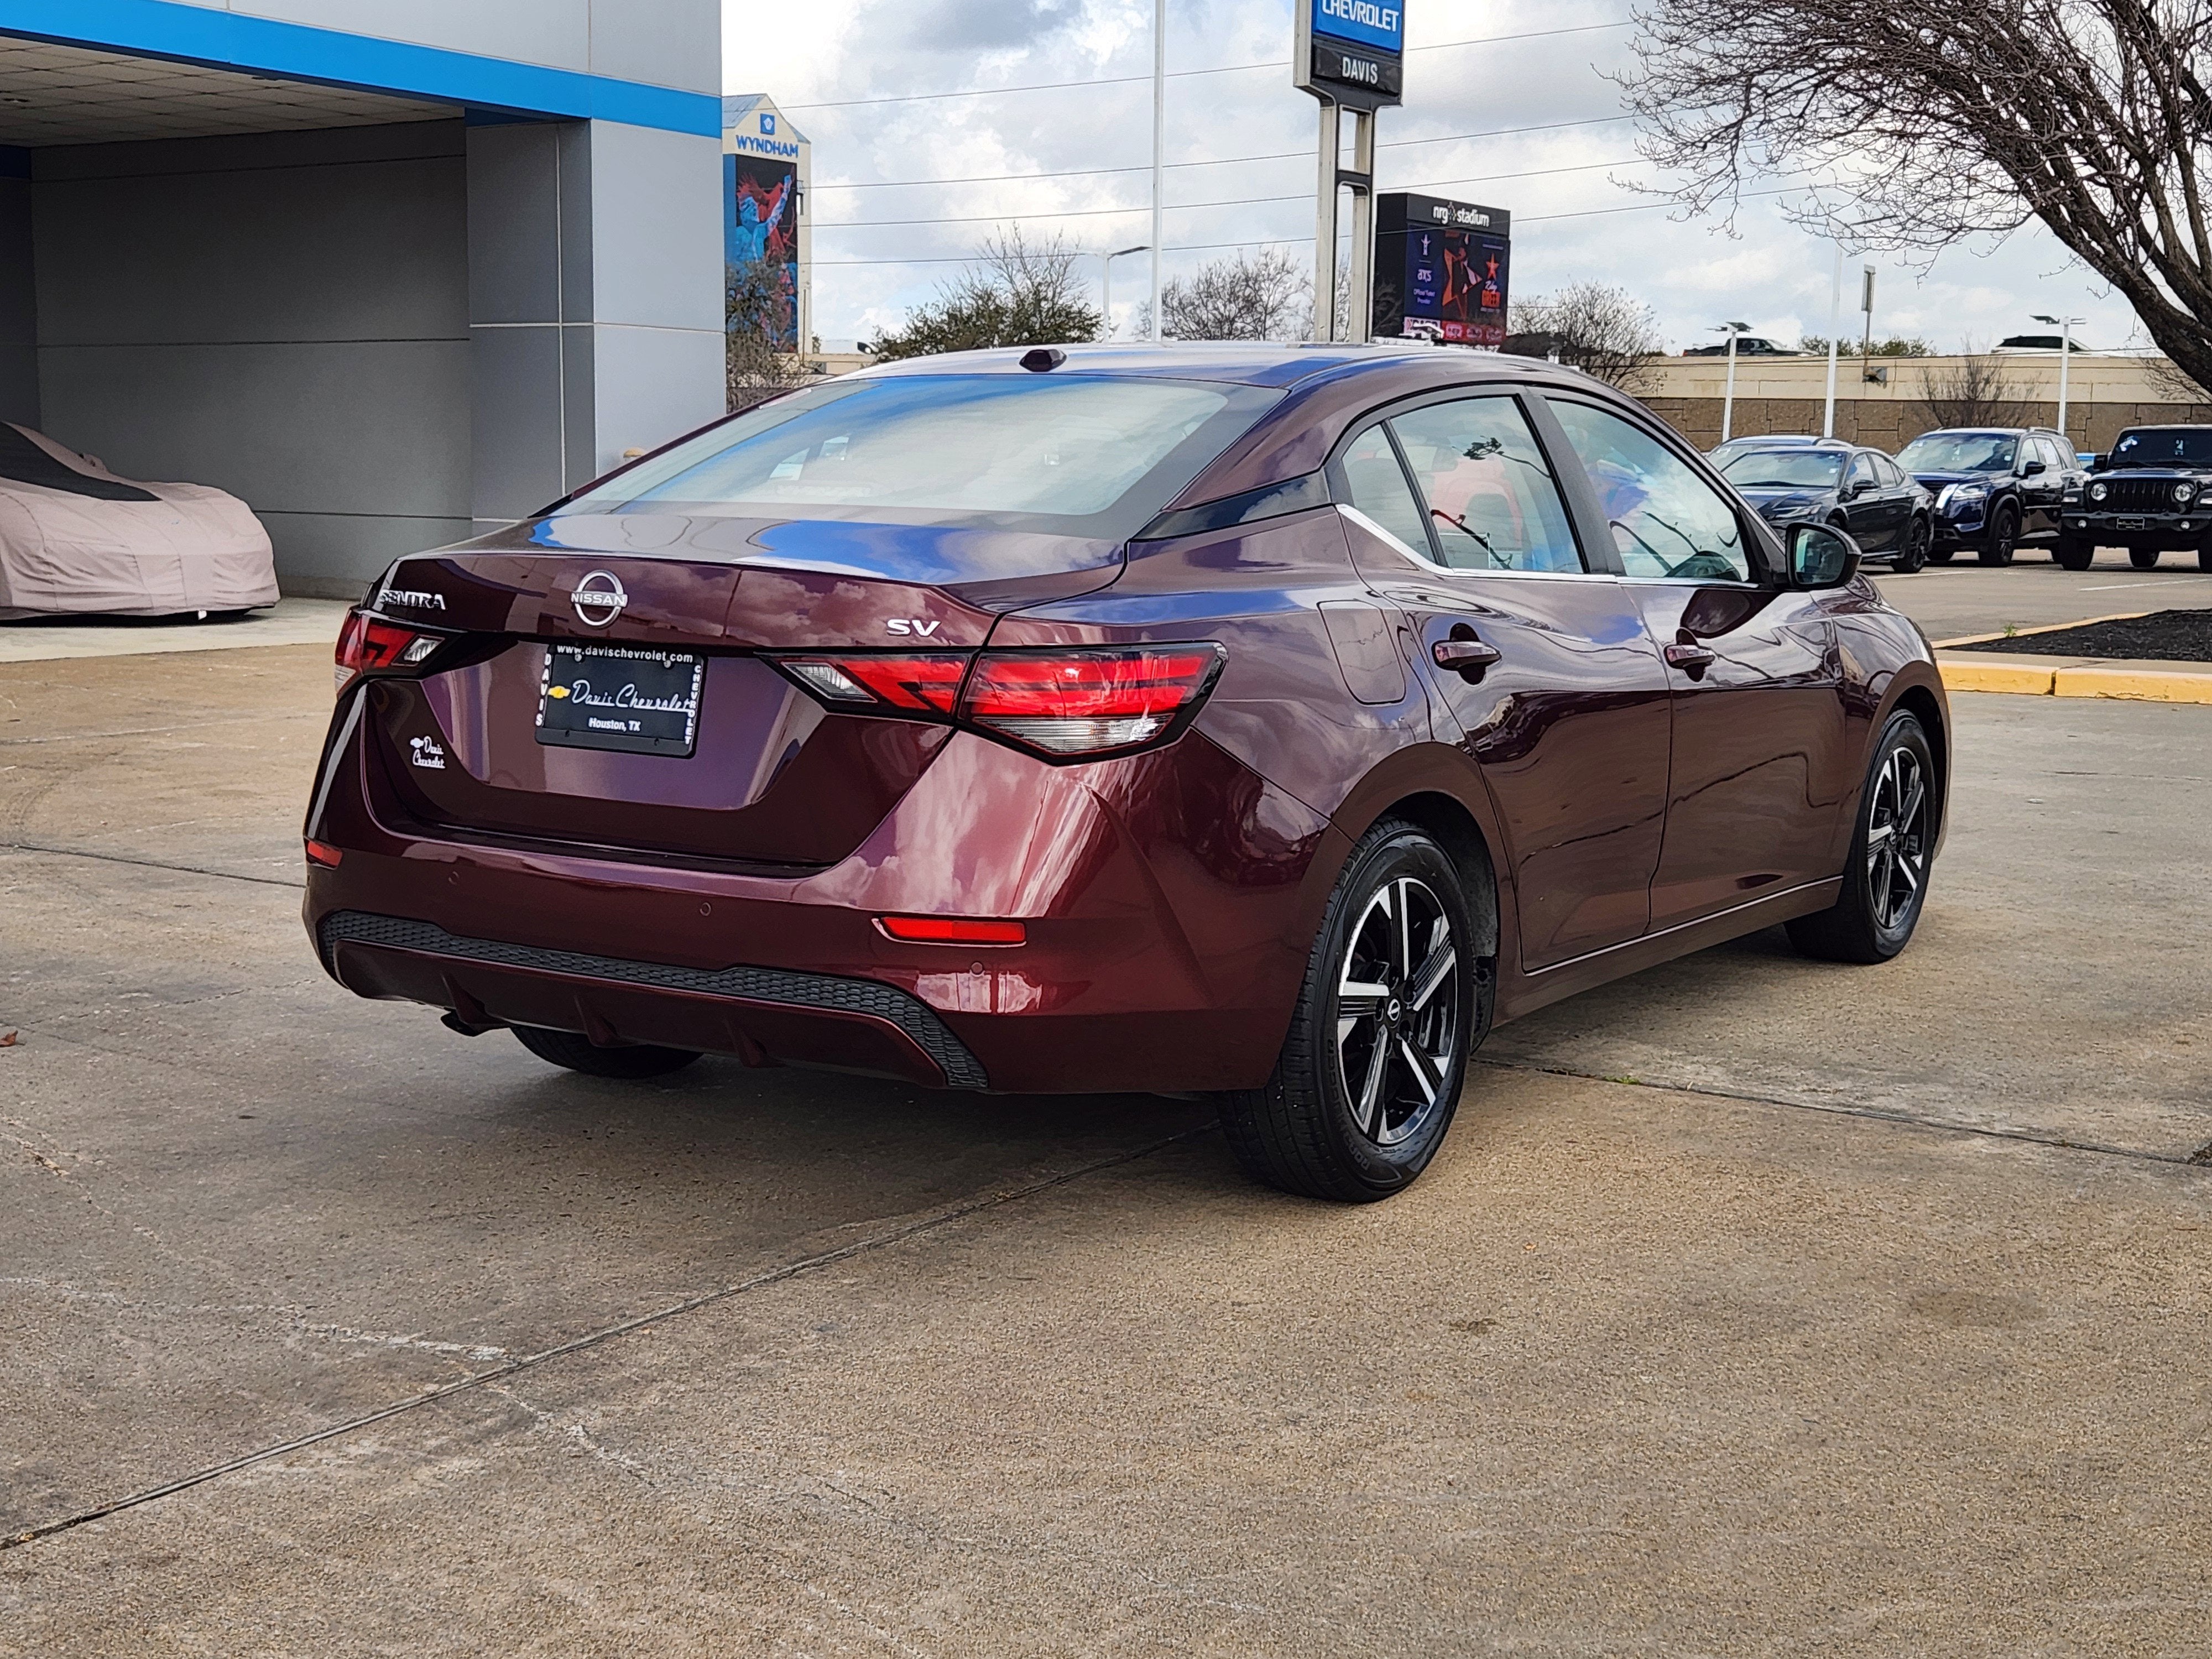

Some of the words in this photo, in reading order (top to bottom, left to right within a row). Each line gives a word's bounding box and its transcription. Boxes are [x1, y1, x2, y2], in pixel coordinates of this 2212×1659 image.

[1322, 0, 1399, 32] CHEVROLET
[1342, 57, 1378, 85] DAVIS
[735, 134, 799, 158] WYNDHAM
[1457, 207, 1489, 227] stadium
[380, 589, 446, 609] SENTRA
[571, 593, 627, 607] NISSAN
[886, 619, 941, 637] SV
[557, 645, 693, 663] www.davischevroletcom
[535, 653, 552, 727] DAVIS
[572, 679, 615, 706] Davis
[615, 684, 691, 713] Chevrolet
[685, 664, 702, 745] CHEVROLET
[588, 717, 627, 732] Houston,
[628, 721, 641, 731] TX
